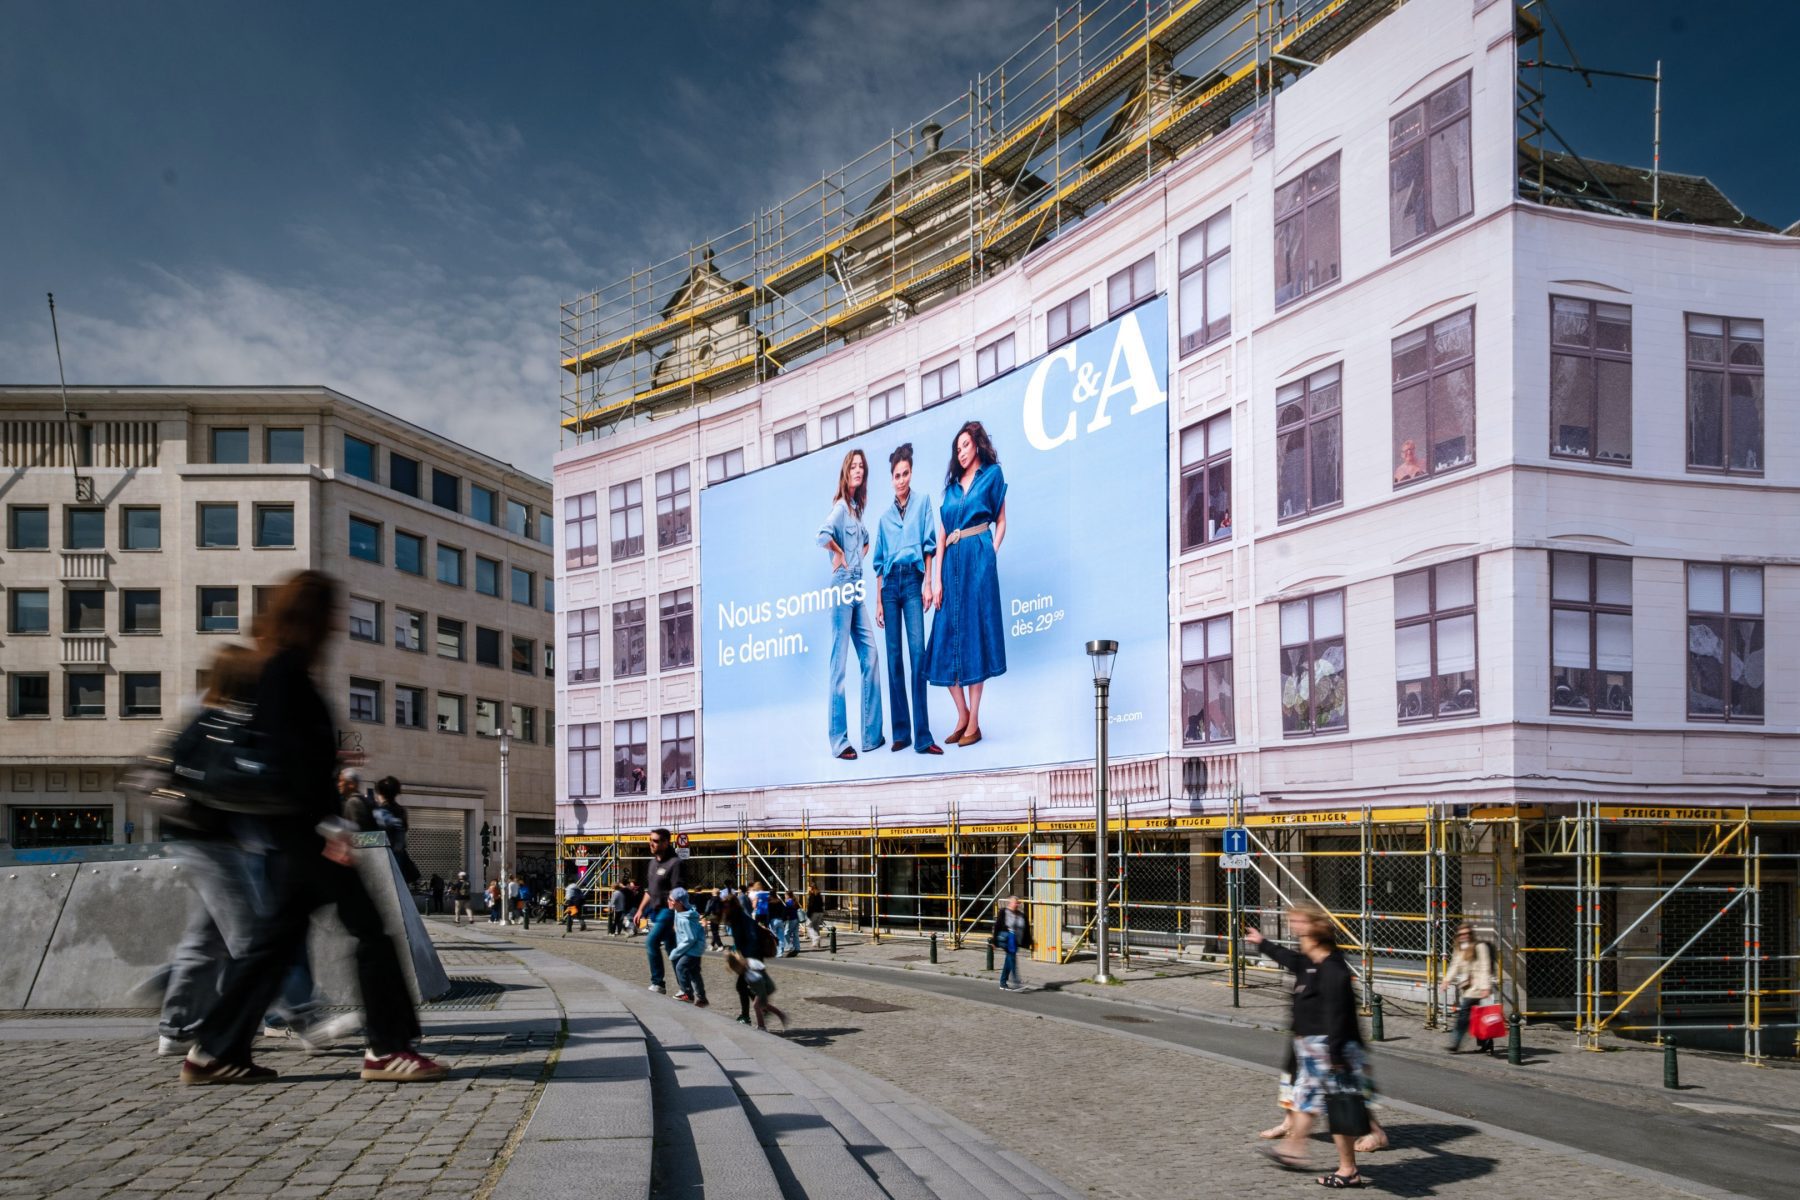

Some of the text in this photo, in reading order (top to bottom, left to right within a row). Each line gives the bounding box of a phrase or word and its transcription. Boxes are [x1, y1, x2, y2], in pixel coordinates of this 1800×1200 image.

[1071, 51, 1123, 98] STEIGER TIJGER
[1168, 76, 1232, 123] STEIGER TIJGER
[1023, 312, 1167, 450] C&A
[718, 579, 866, 631] Nous sommes
[1011, 593, 1053, 616] Denim
[1011, 619, 1033, 637] dès
[718, 629, 809, 667] le denim.
[1146, 819, 1177, 827] STEIGER
[1623, 809, 1717, 819] STEIGER TIJGER
